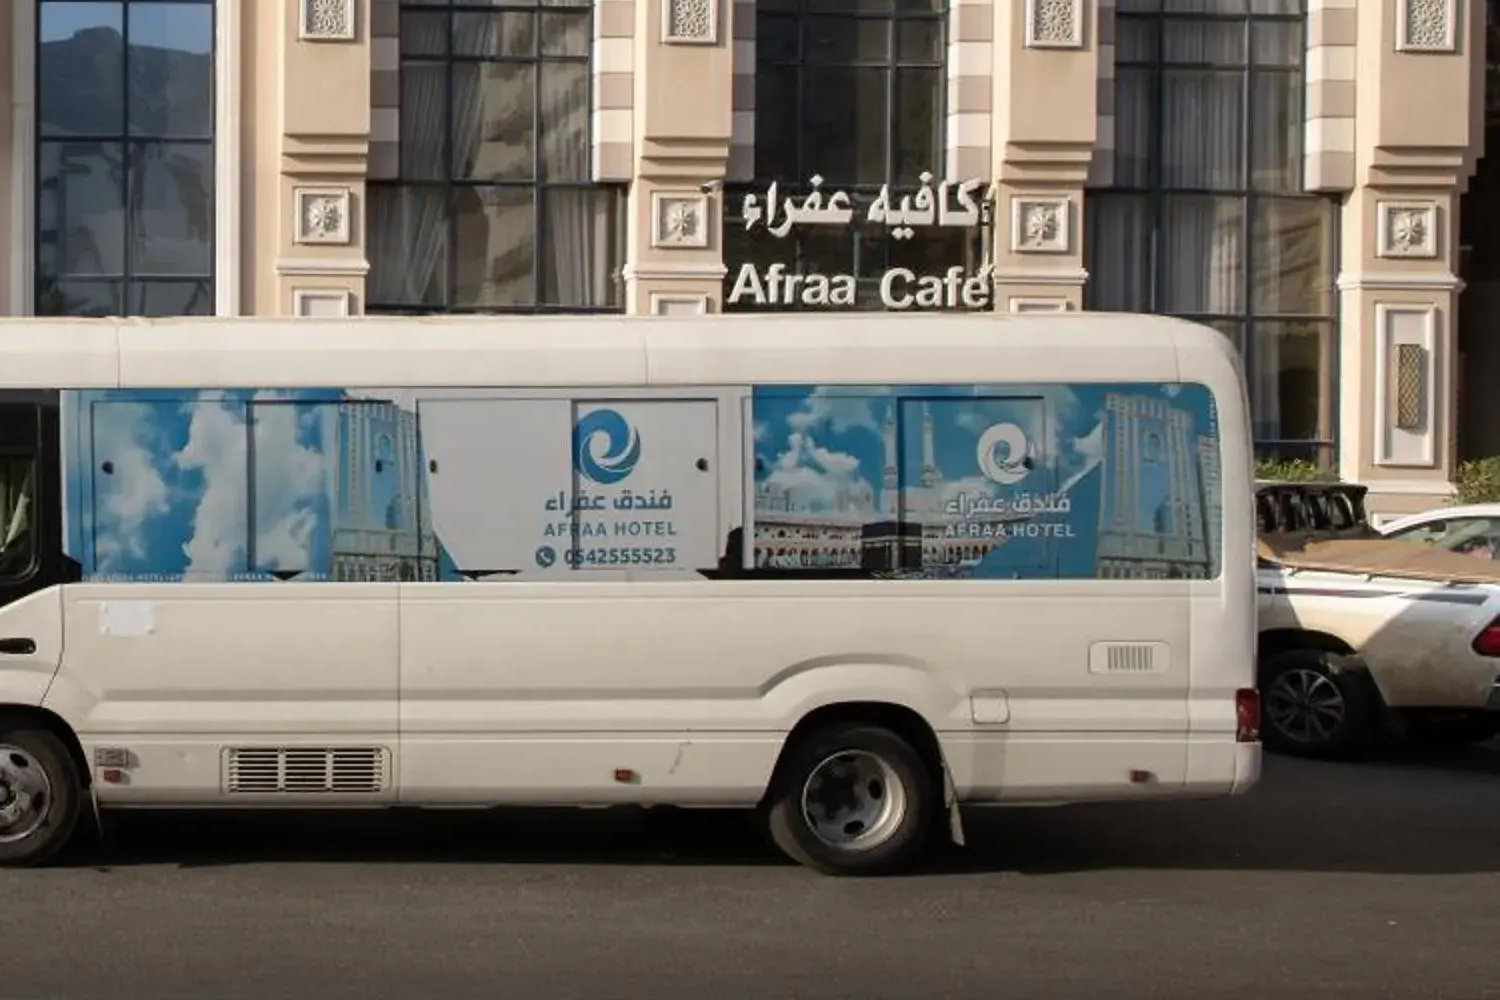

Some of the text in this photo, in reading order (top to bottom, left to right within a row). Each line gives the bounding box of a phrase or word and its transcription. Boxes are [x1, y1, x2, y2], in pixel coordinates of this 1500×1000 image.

[742, 171, 982, 240] كافيه عفراء
[727, 263, 856, 305] Afraa
[613, 489, 673, 511] فندق
[945, 491, 1071, 518] فندق عفراء
[614, 521, 678, 536] HOTEL
[945, 522, 1077, 537] AFRAA HOTEL
[564, 547, 677, 565] 0542555523
